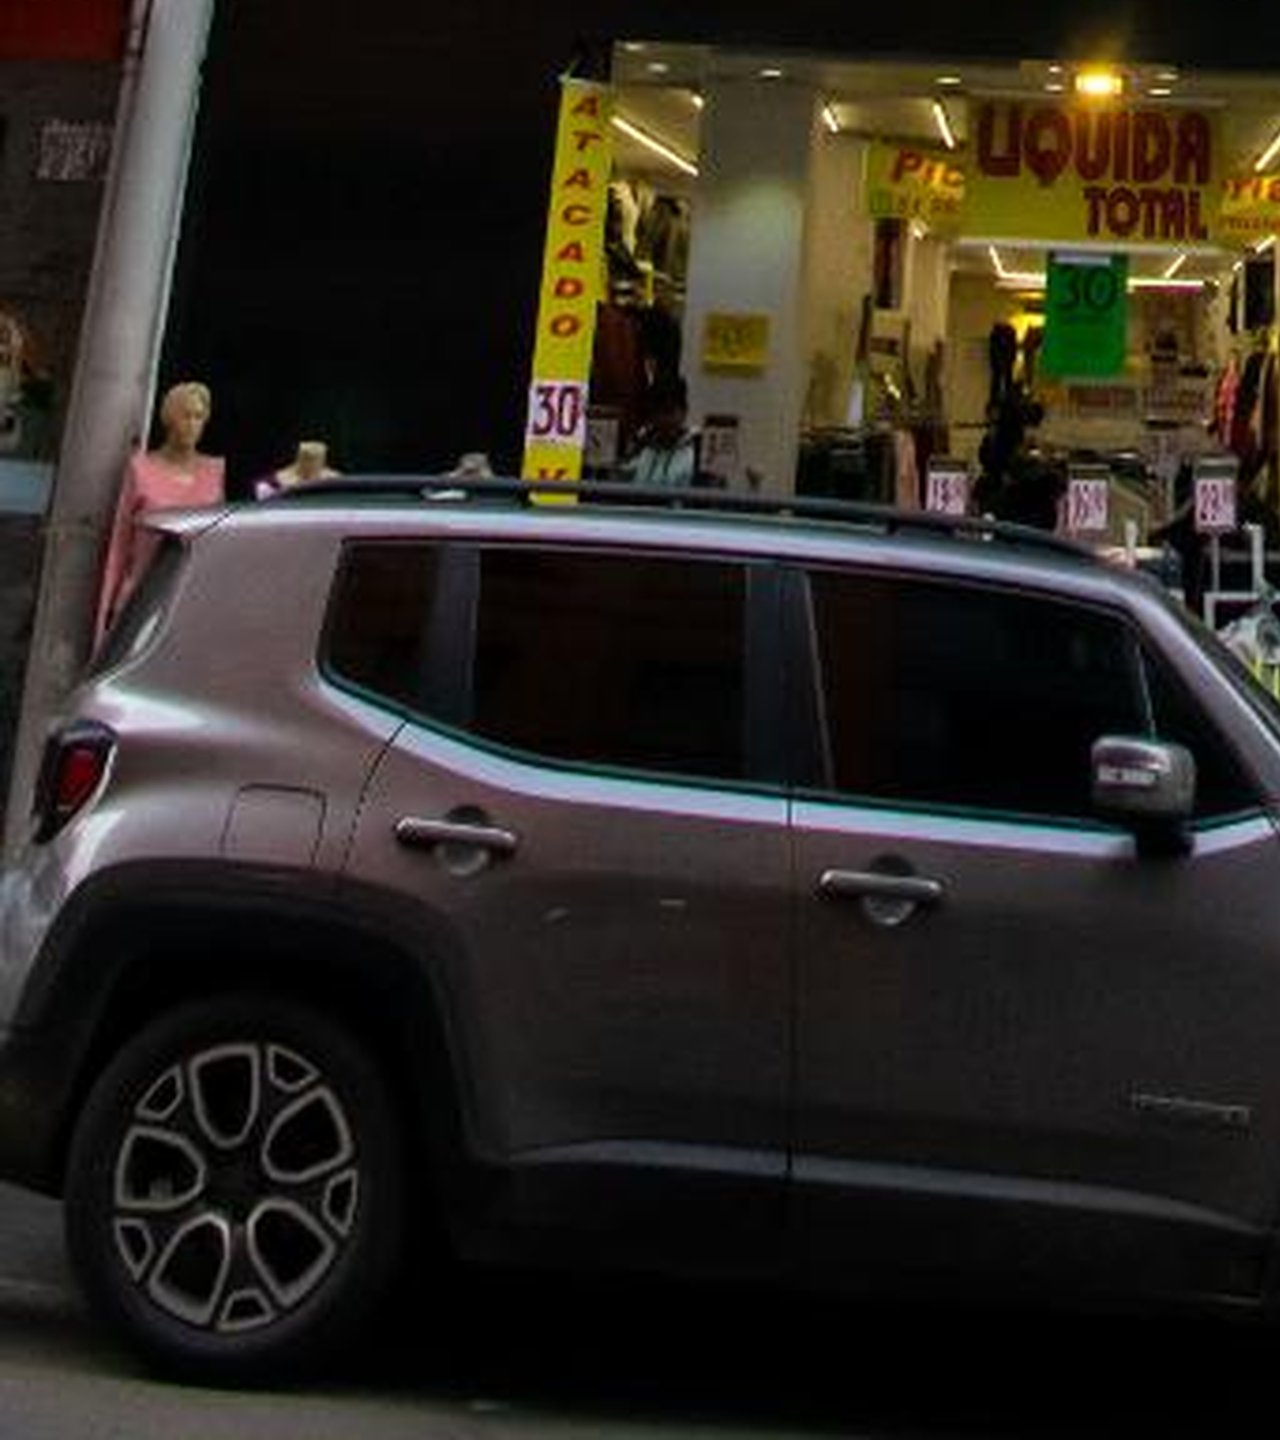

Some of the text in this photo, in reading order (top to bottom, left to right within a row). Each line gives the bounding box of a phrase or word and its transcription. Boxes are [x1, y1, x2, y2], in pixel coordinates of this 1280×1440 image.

[975, 103, 1212, 187] LIQUIDA
[549, 95, 600, 338] ATACADO
[1083, 186, 1209, 241] TOTAL
[532, 385, 582, 437] 30
